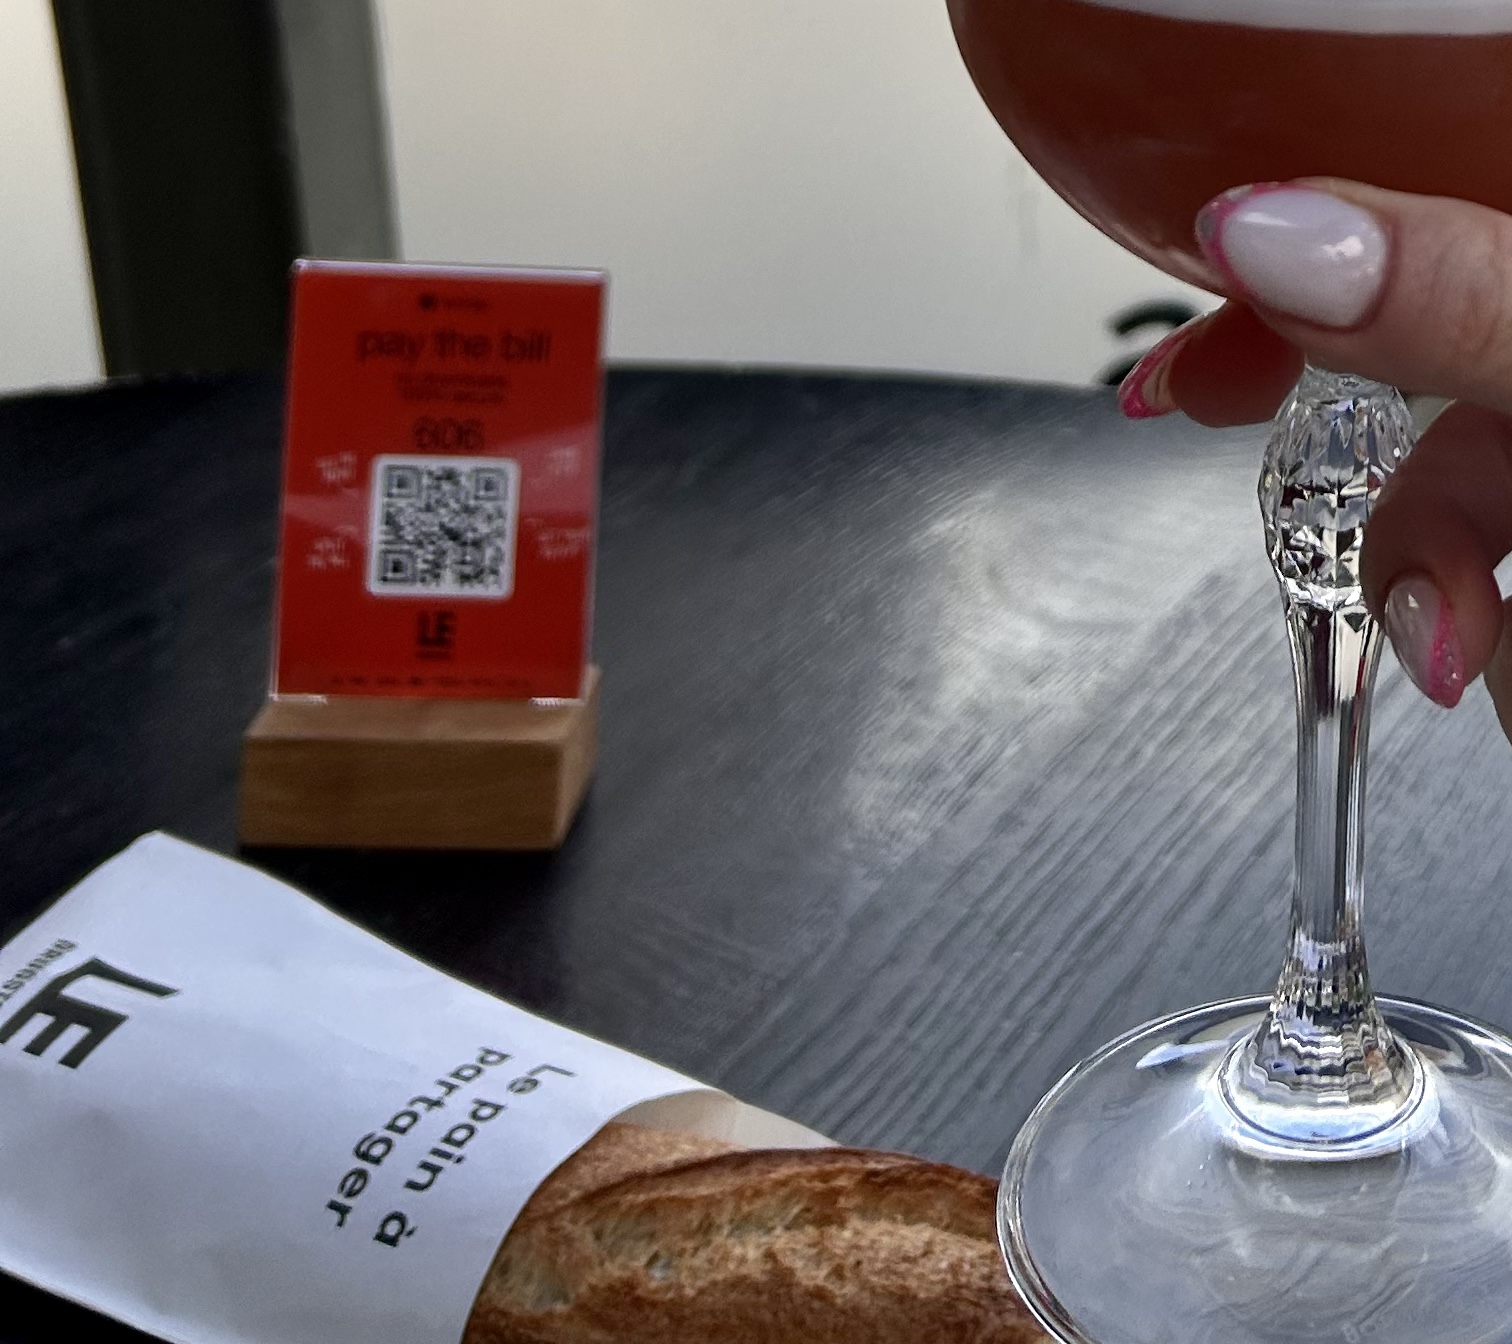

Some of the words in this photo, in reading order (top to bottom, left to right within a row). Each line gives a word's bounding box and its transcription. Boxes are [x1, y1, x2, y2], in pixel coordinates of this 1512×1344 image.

[356, 330, 426, 365] pay
[433, 329, 492, 361] the
[500, 330, 553, 363] bill
[0, 957, 180, 1069] LE
[507, 1063, 576, 1095] Le
[326, 1046, 512, 1228] partager
[403, 1097, 507, 1192] pain
[373, 1210, 418, 1247] à
